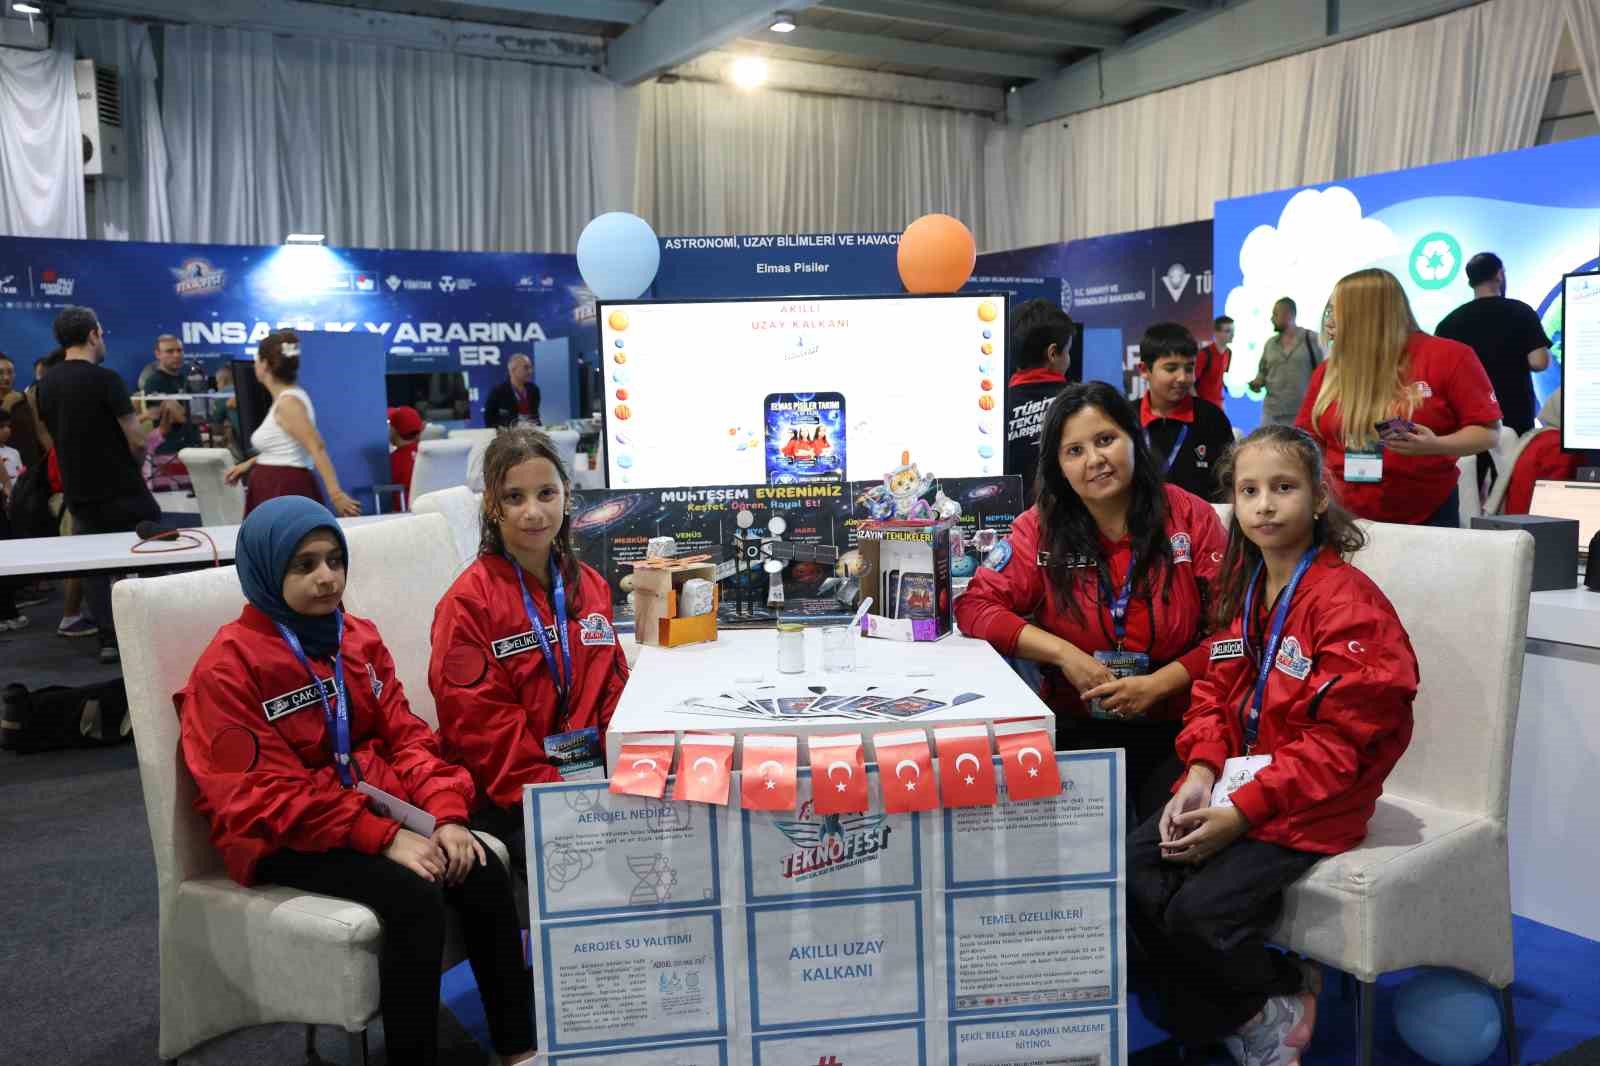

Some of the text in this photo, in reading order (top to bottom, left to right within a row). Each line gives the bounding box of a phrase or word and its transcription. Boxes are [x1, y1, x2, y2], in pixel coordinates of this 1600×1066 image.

[665, 235, 740, 249] ASTRONOMİ,
[743, 236, 774, 248] UZAY
[777, 234, 836, 247] BİLİMLERİ
[838, 235, 854, 246] VE
[756, 261, 830, 274] Elmas Pisiler
[751, 319, 849, 330] UZAY KALKANI
[577, 811, 627, 825] AEROJEL
[781, 825, 891, 878] TEKNOFEST
[979, 908, 1084, 926] TEMEL ÖZELLİKLERİ
[573, 934, 693, 954] AEROJEL SU YALITIMI
[789, 940, 885, 960] AKILLI UZAY
[802, 963, 873, 982] KALKANI
